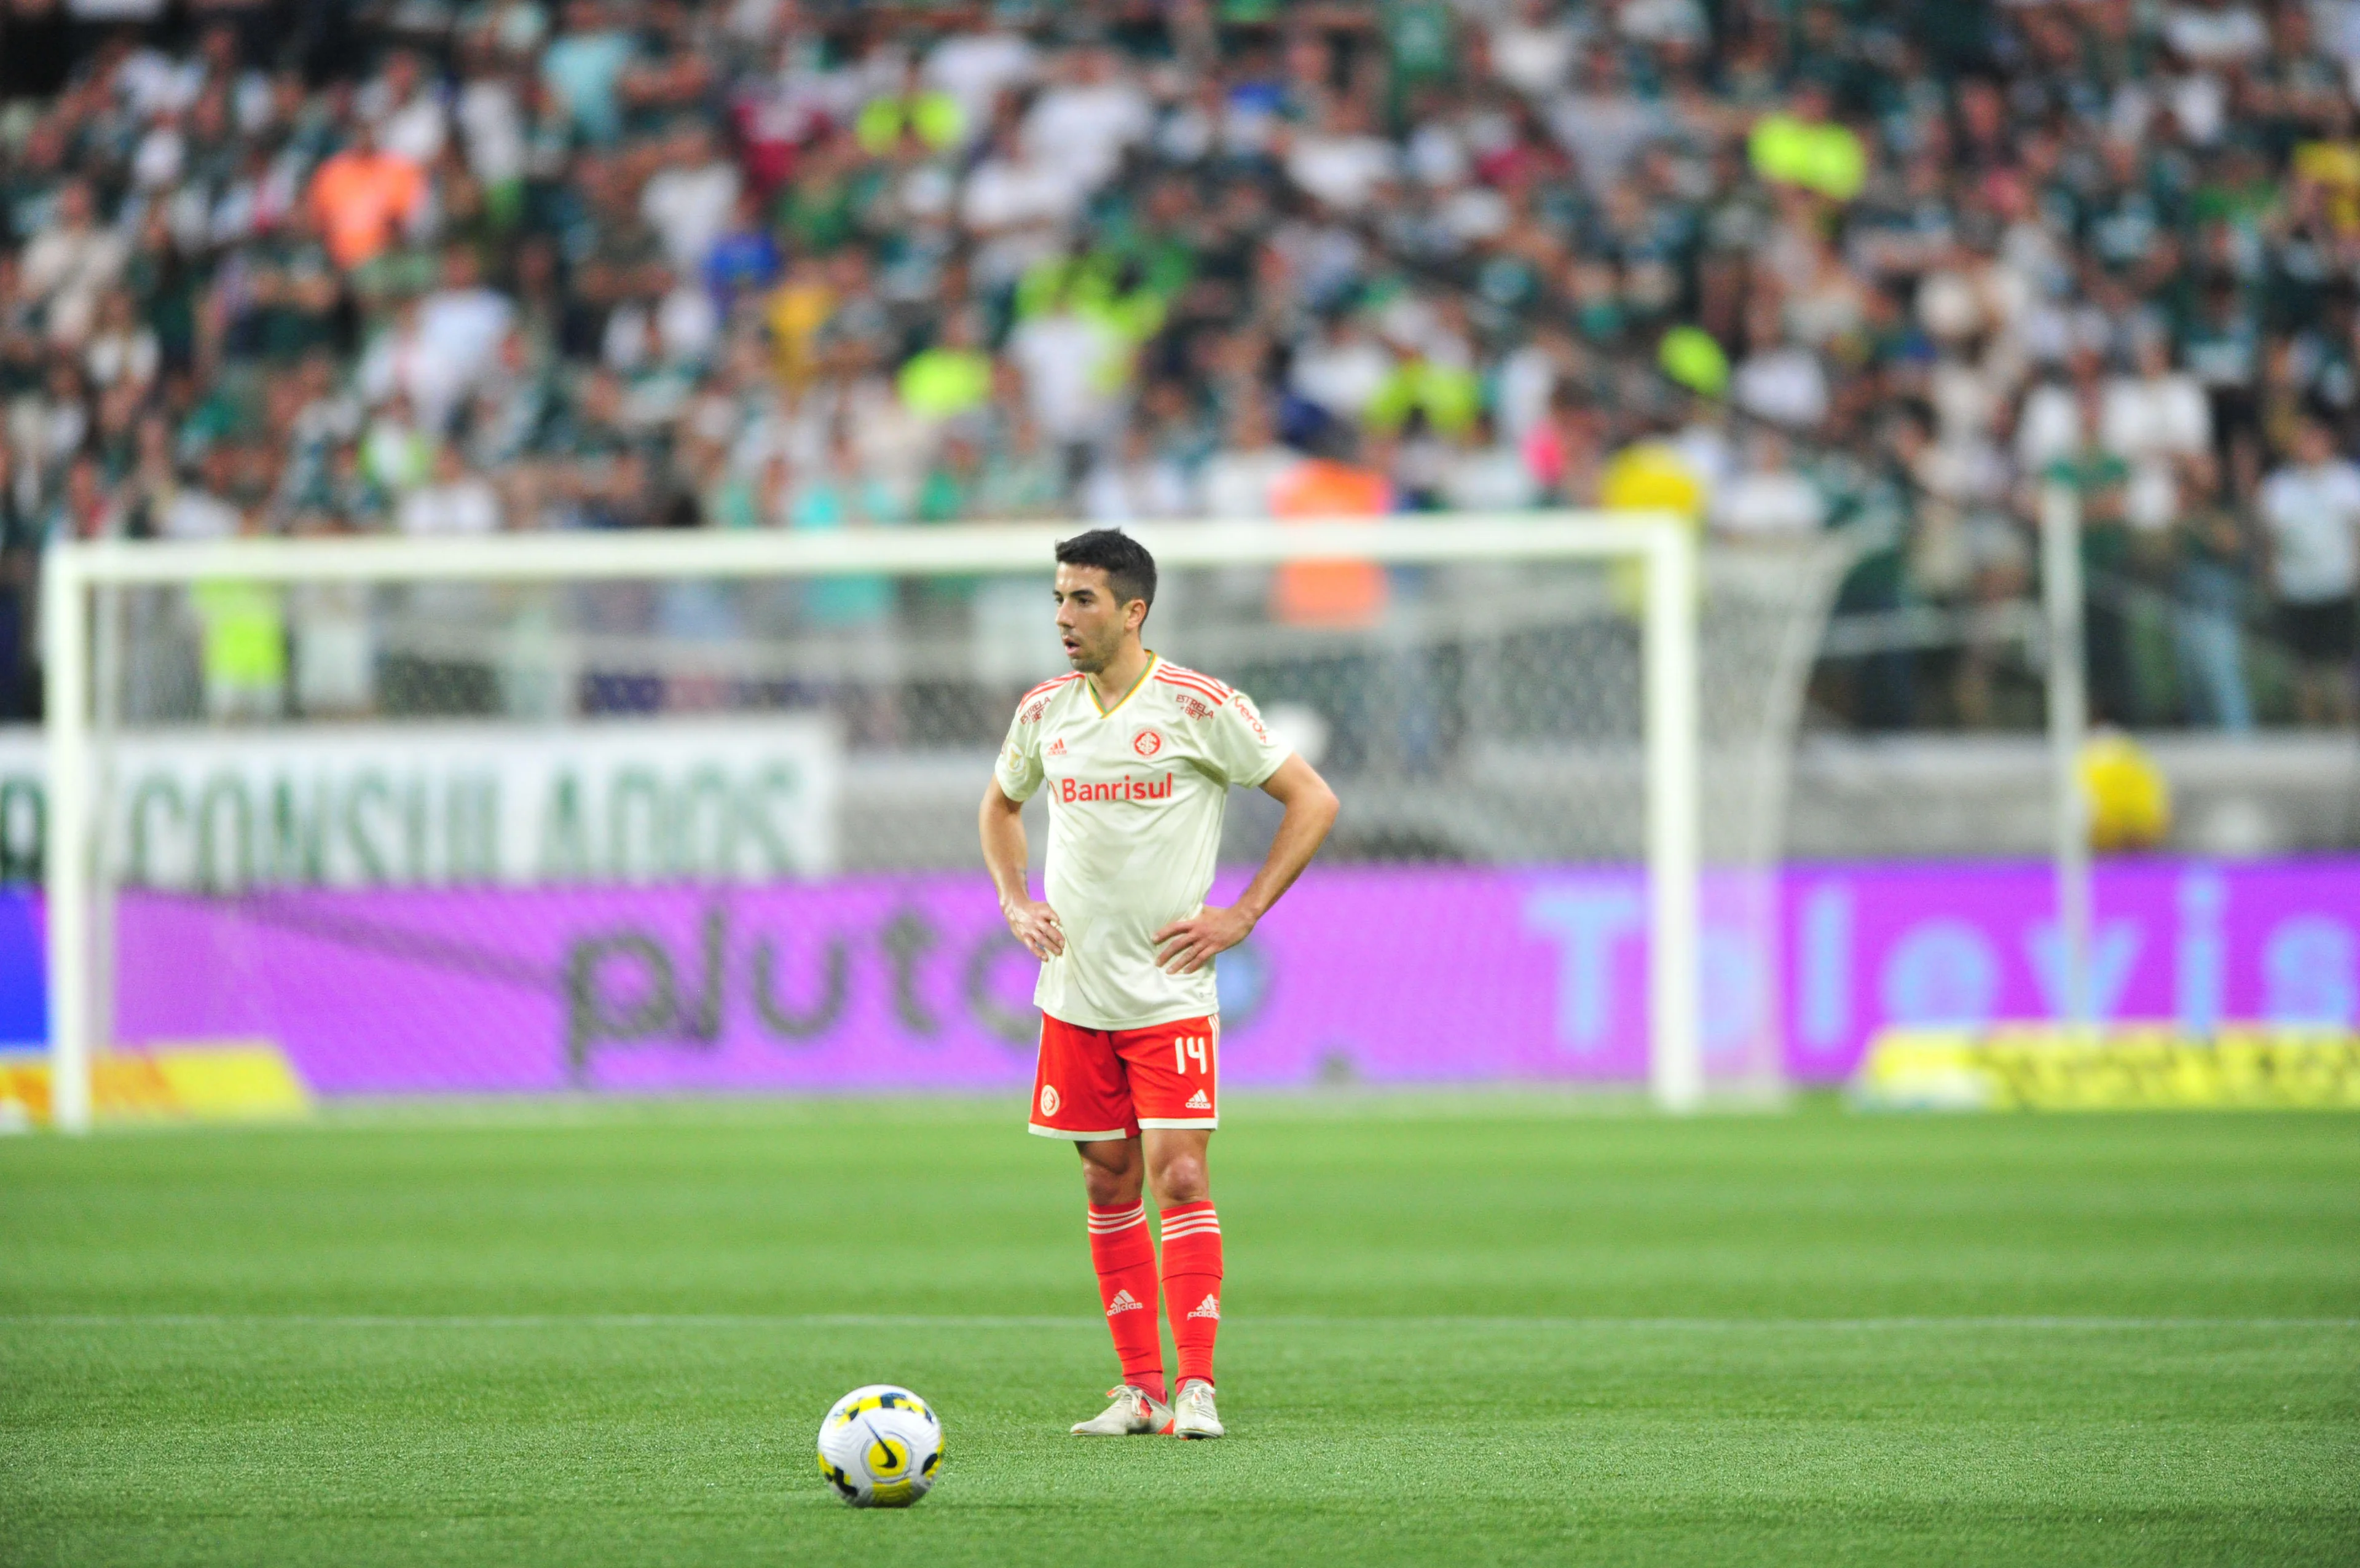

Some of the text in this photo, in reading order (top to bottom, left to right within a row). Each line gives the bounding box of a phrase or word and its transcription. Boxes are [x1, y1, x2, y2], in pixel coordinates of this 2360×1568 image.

[1021, 696, 1051, 725] ESTRELA
[1176, 694, 1214, 719] ESTRELA
[1185, 706, 1205, 721] BET
[1061, 772, 1173, 803] Banrisul
[1175, 1037, 1207, 1075] 14
[1106, 1302, 1144, 1317] adidas
[1187, 1311, 1221, 1320] adidas
